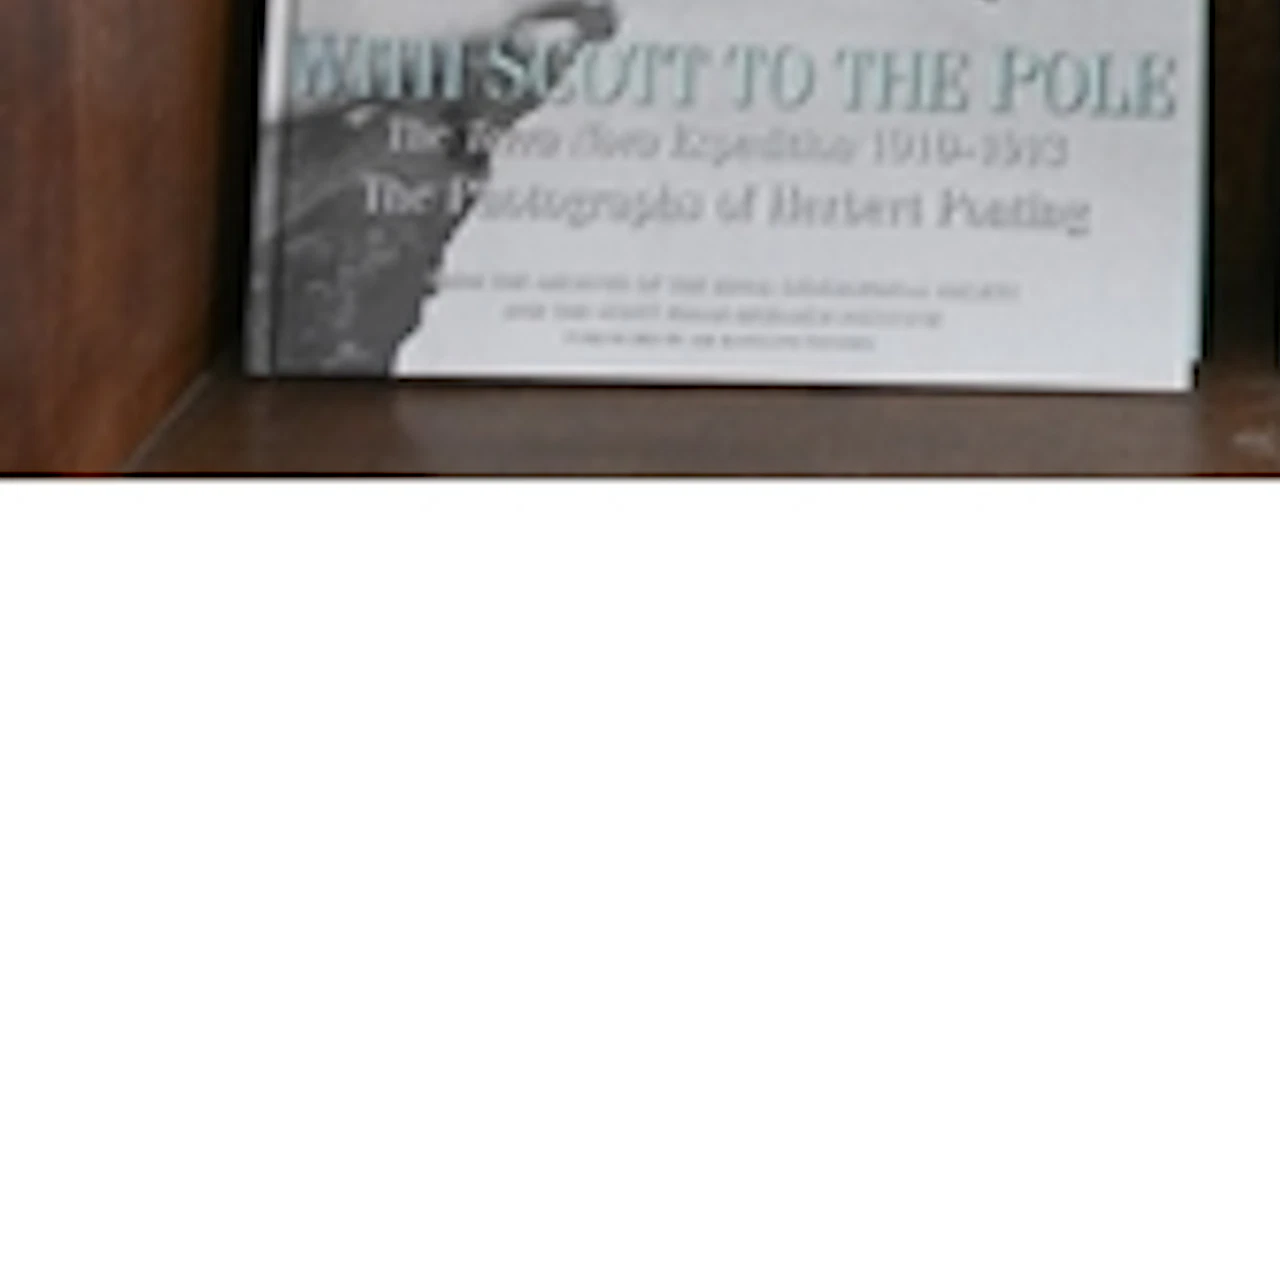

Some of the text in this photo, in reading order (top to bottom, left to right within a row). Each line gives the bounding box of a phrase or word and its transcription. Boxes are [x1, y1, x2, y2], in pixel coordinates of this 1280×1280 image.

[290, 36, 1179, 120] WITH SCOTT TO THE POLE
[361, 176, 1091, 236] The Photographs of Herbert Ponting
